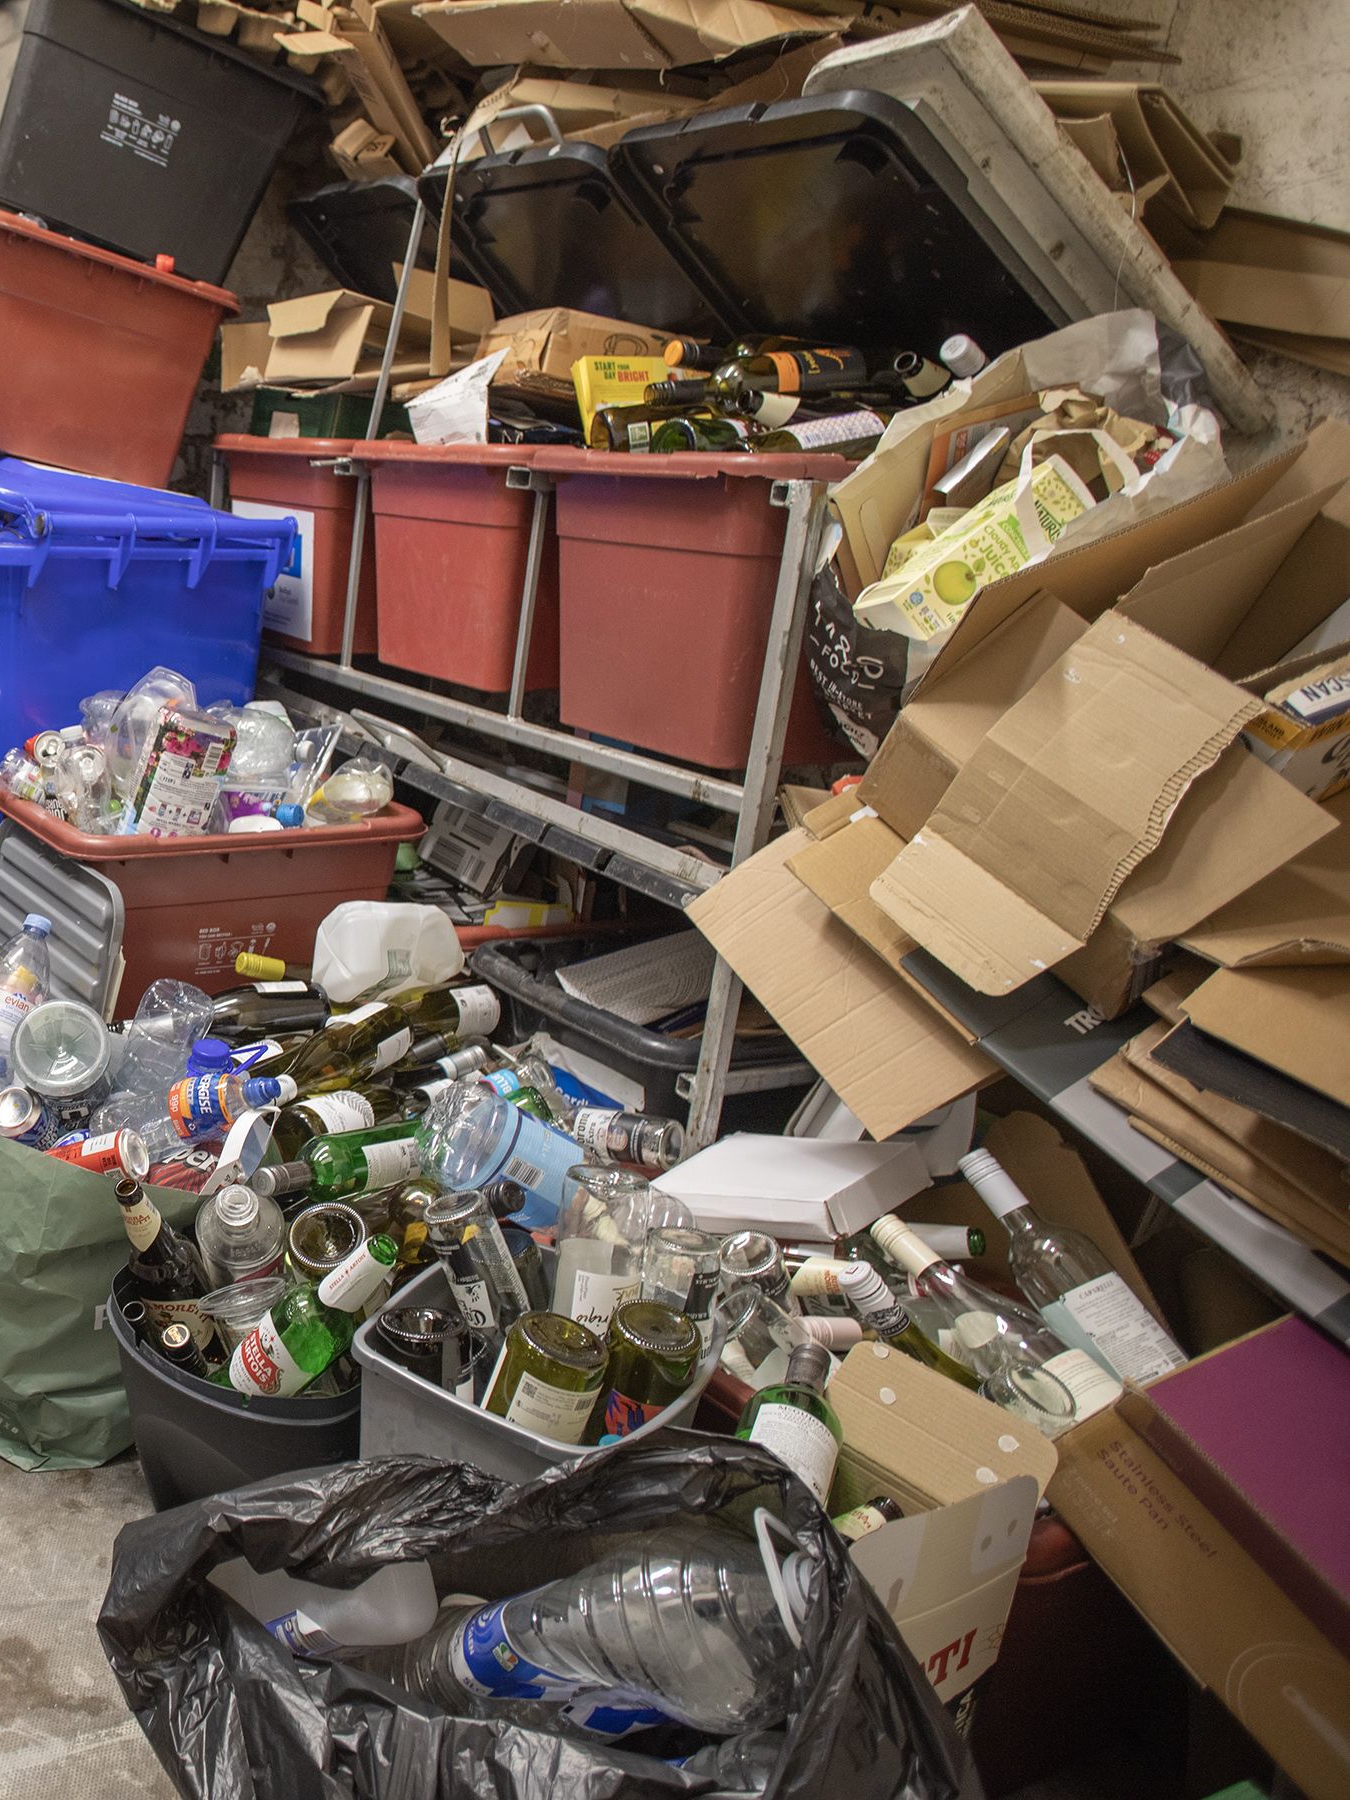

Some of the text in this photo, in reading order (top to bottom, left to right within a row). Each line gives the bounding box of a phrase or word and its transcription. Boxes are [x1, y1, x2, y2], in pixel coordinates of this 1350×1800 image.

[594, 362, 616, 371] START
[618, 371, 650, 382] BRIGHT
[984, 525, 1011, 555] Cloudy
[979, 553, 1011, 587] Juice
[4, 995, 30, 1012] evian
[171, 1094, 179, 1113] 99p
[576, 1112, 590, 1146] orona
[329, 1274, 345, 1291] STELLA
[243, 1339, 269, 1384] ARTOIS
[250, 1333, 273, 1378] STELLA
[1098, 1448, 1169, 1531] Saute Pan
[1110, 1440, 1175, 1513] Stainless
[1174, 1513, 1218, 1559] Steel
[920, 1627, 978, 1687] TI
